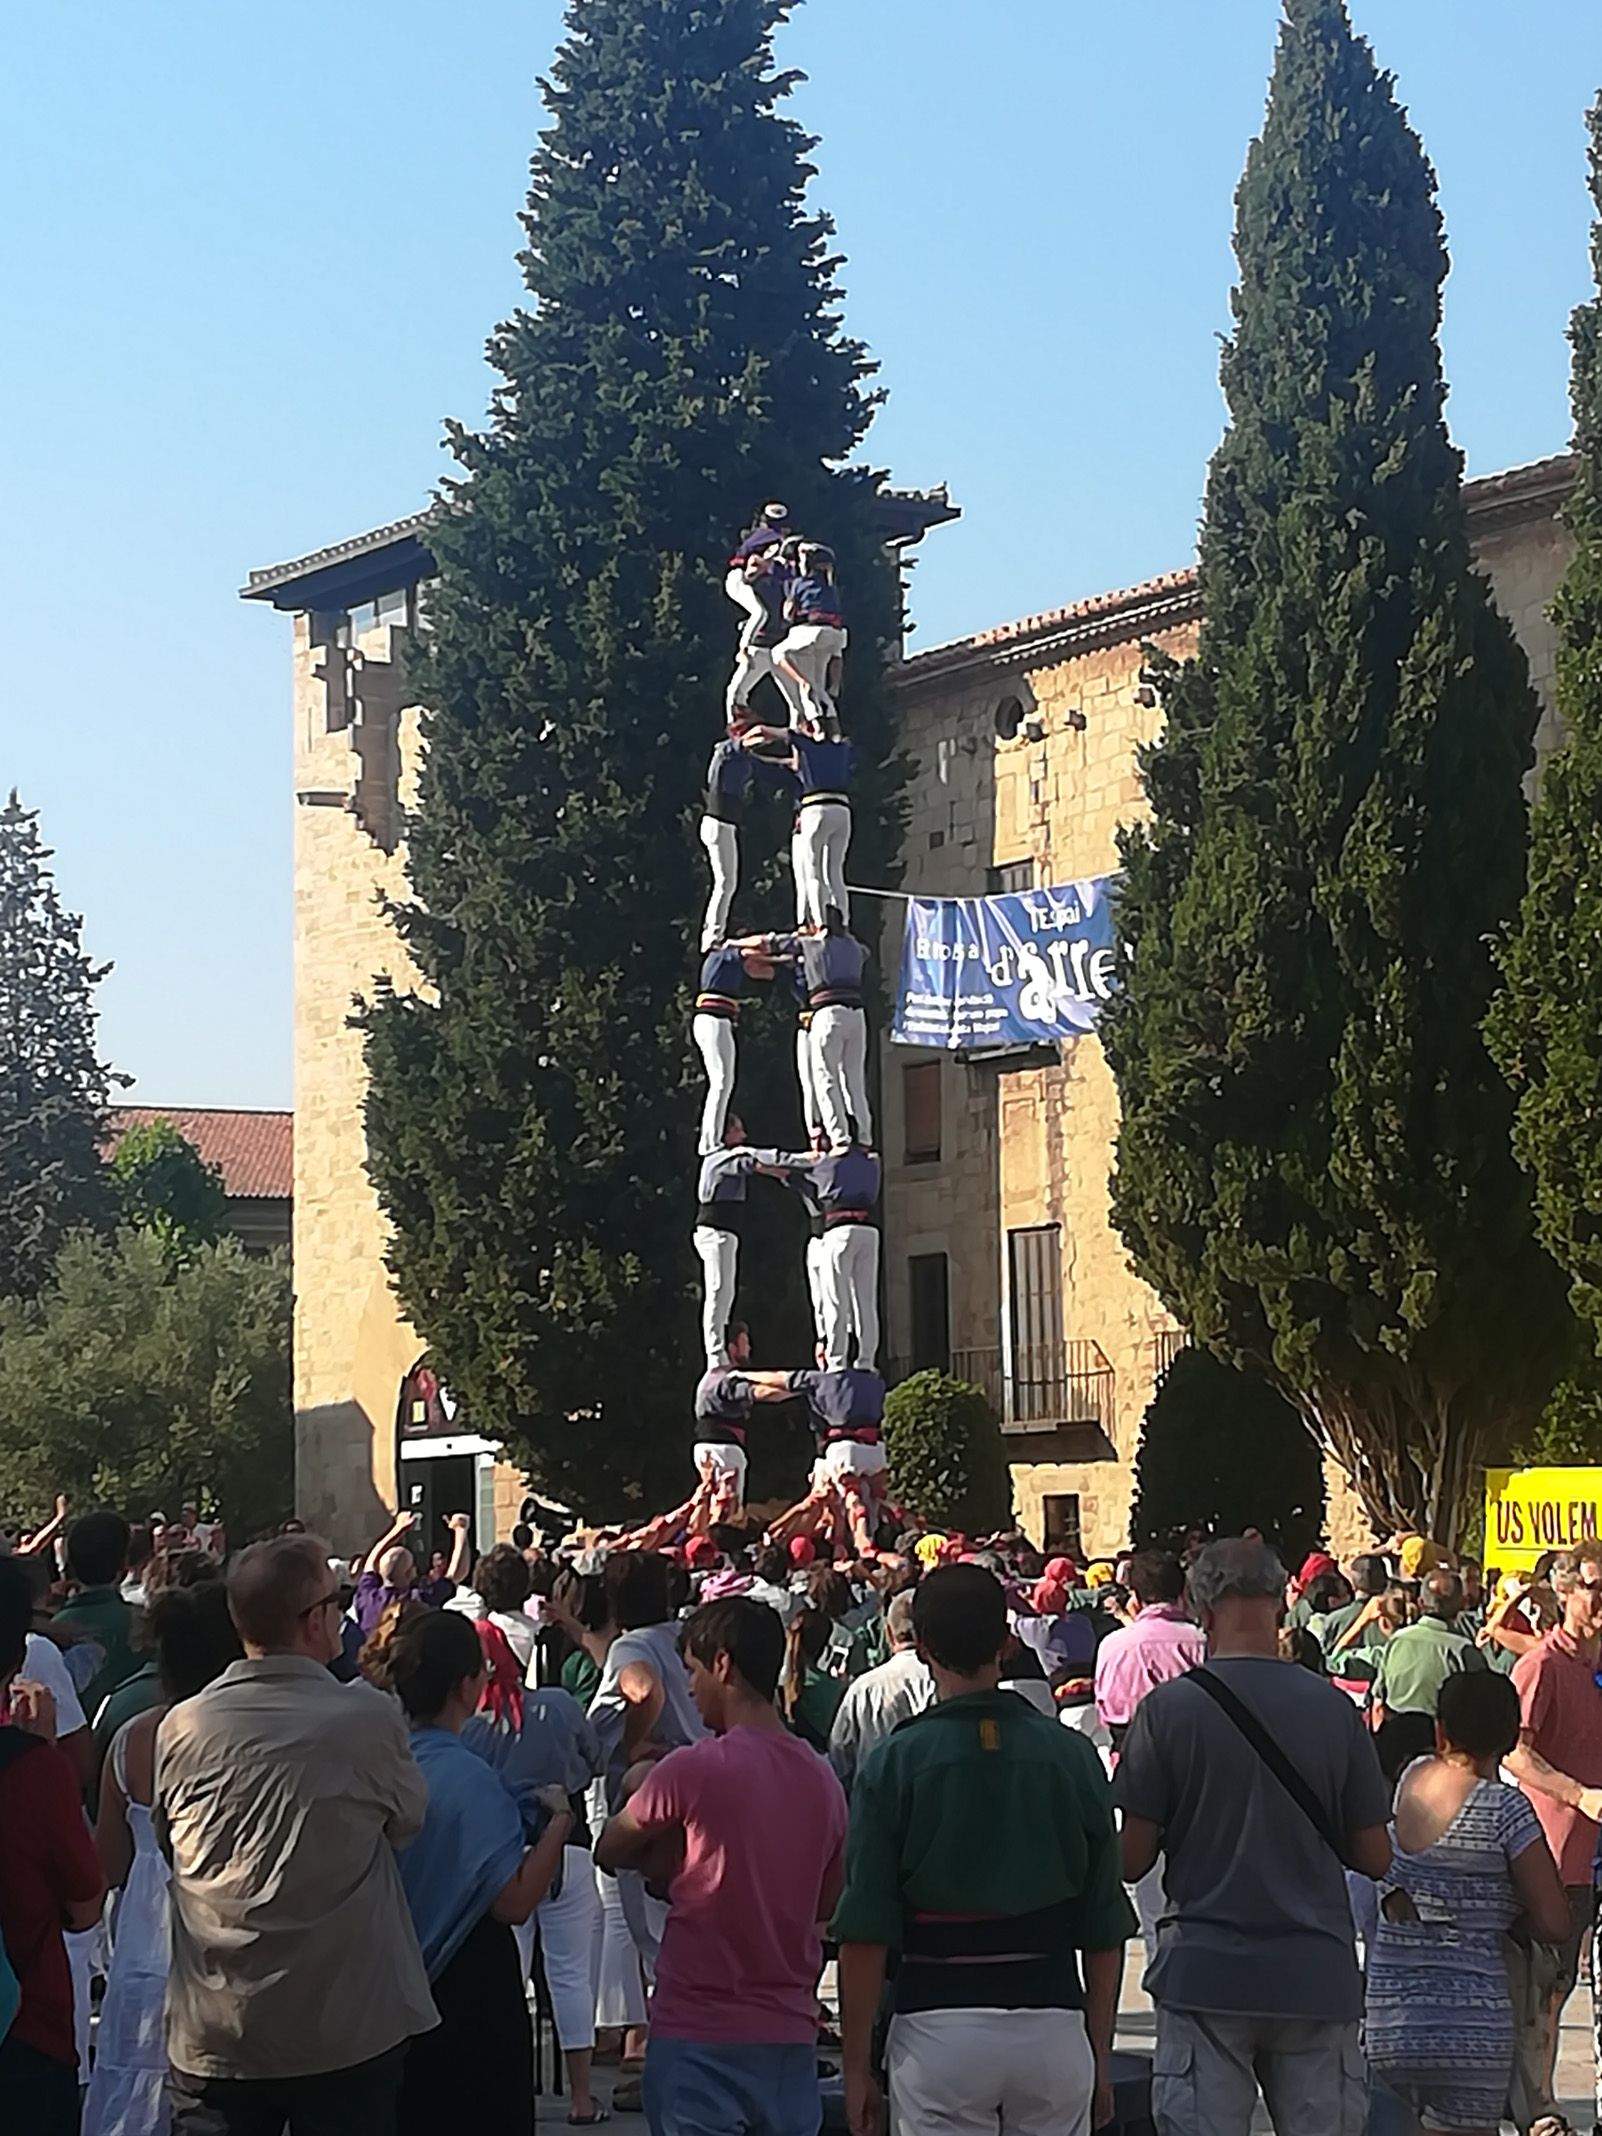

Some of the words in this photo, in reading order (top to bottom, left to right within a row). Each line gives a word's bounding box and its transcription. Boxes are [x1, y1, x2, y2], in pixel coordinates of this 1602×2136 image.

[990, 939, 1134, 1024] d'arre
[1497, 1501, 1524, 1544] US
[1528, 1501, 1598, 1545] VOLEM
